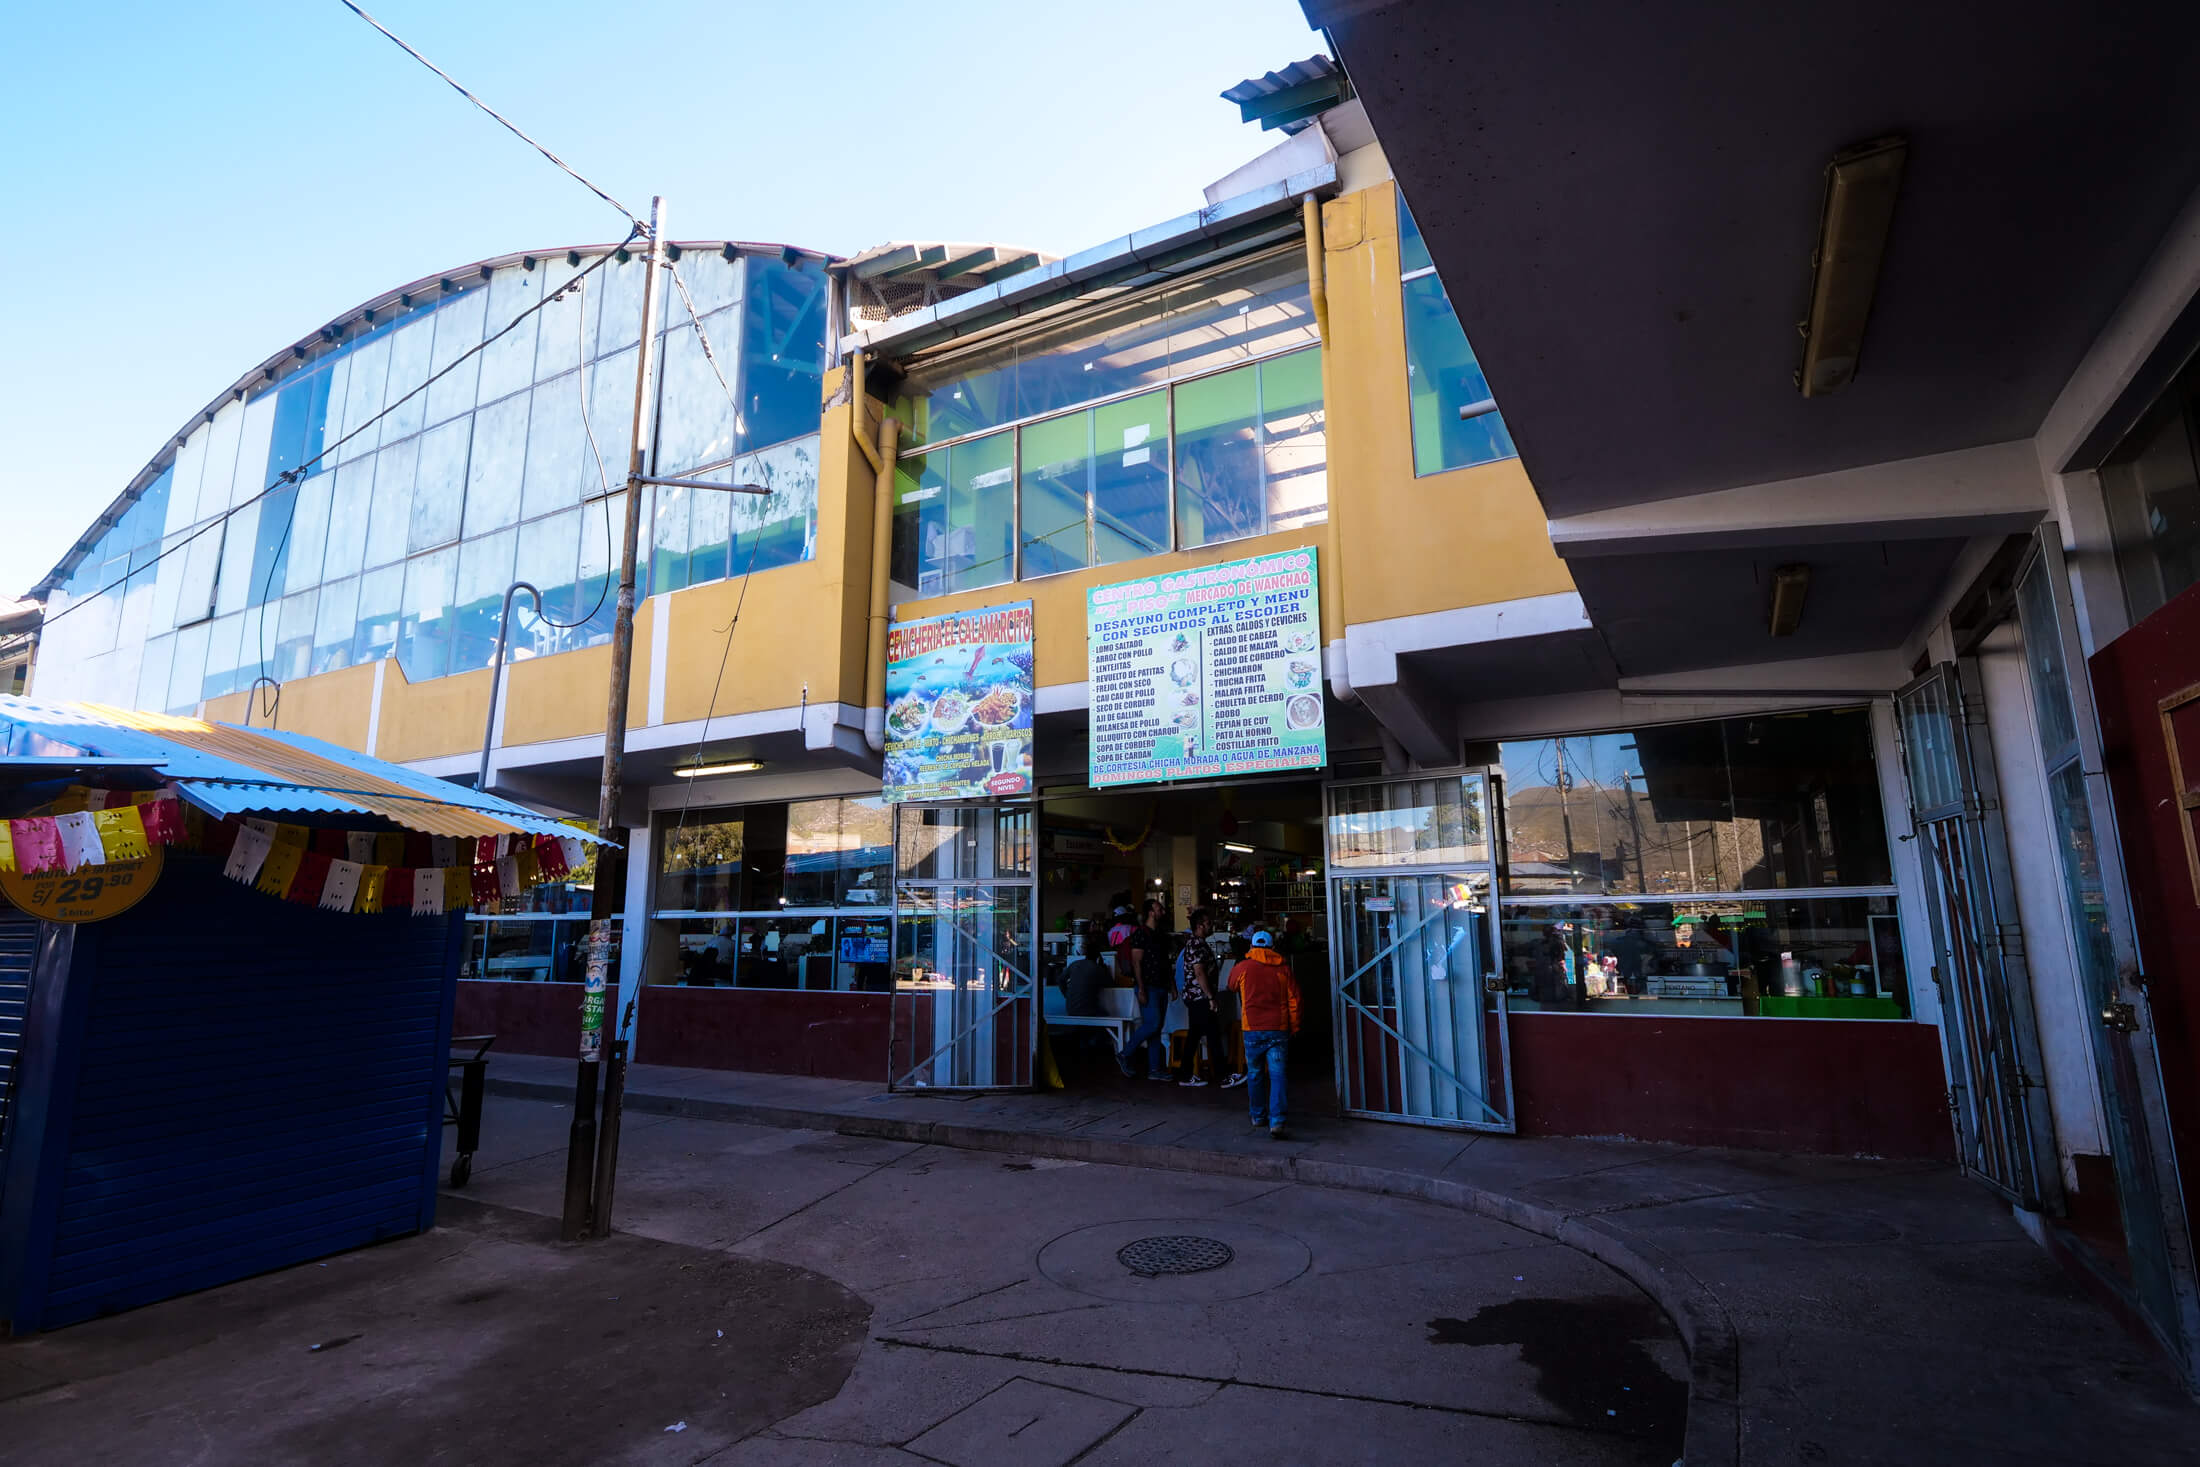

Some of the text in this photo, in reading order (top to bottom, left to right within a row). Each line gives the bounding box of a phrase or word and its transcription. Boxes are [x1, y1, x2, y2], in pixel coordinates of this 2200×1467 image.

[1093, 554, 1310, 604] CENTRO GASTRONÓMICO
[1185, 584, 1235, 605] MERCADO
[1238, 581, 1251, 594] DE
[1254, 571, 1310, 592] WANCHAQ
[1095, 589, 1309, 632] DESAYUNO COMPLETO Y MENU
[1103, 603, 1300, 641] CON SEGUNDOS AL ESCOJER
[1236, 619, 1263, 632] CALDOS
[1265, 618, 1269, 627] Y
[1271, 613, 1307, 626] CEVICHES
[888, 608, 1031, 663] CEVICHERIA EL CALAMARCITO
[1213, 630, 1277, 646] CALDO DE CABEZA
[1096, 640, 1143, 653] LOMO SALTADO
[1213, 640, 1278, 656] CALDO DE MALAYA
[1096, 648, 1153, 663] ARROZ CON POLLO
[1214, 650, 1285, 667] CALDO DE CORDERO
[1096, 661, 1131, 673] LENTEJITAS
[1214, 664, 1262, 677] CHICHARRON
[1096, 667, 1165, 683] REVUELTO DE PATITAS
[1214, 674, 1265, 687] TRUCHA FRITA
[1096, 678, 1151, 693] FREJOL CON SECO
[1215, 685, 1264, 698] MALAYA FRITA
[1096, 688, 1155, 702] CAU CAU DE POLLO
[1215, 693, 1284, 708] CHULETA DE CERDO
[1096, 698, 1155, 713] SECO DE CORDERO
[1096, 710, 1143, 722] AJI DE GALLINA
[1215, 709, 1240, 719] ADOBO
[1096, 718, 1160, 732] MILANESA DE POLLO
[1215, 716, 1269, 729] PEPIAN DE CUY
[1096, 726, 1179, 742] OLLUQUITO CON CHARQUI
[1215, 727, 1271, 740] PATO AL HORNO
[1096, 740, 1155, 753] SOPA DE CORDERO
[1215, 737, 1279, 750] COSTILLAR FRITO
[1094, 745, 1319, 773] DE CORTESIA CHICHA MORADA O AGUA DE MANZANA
[1096, 750, 1152, 763] SOPA DE CARDAN
[1093, 755, 1321, 783] DOMINGOS PLATOS ESPECIALES
[992, 777, 1020, 792] SEGUNDO NIVEL
